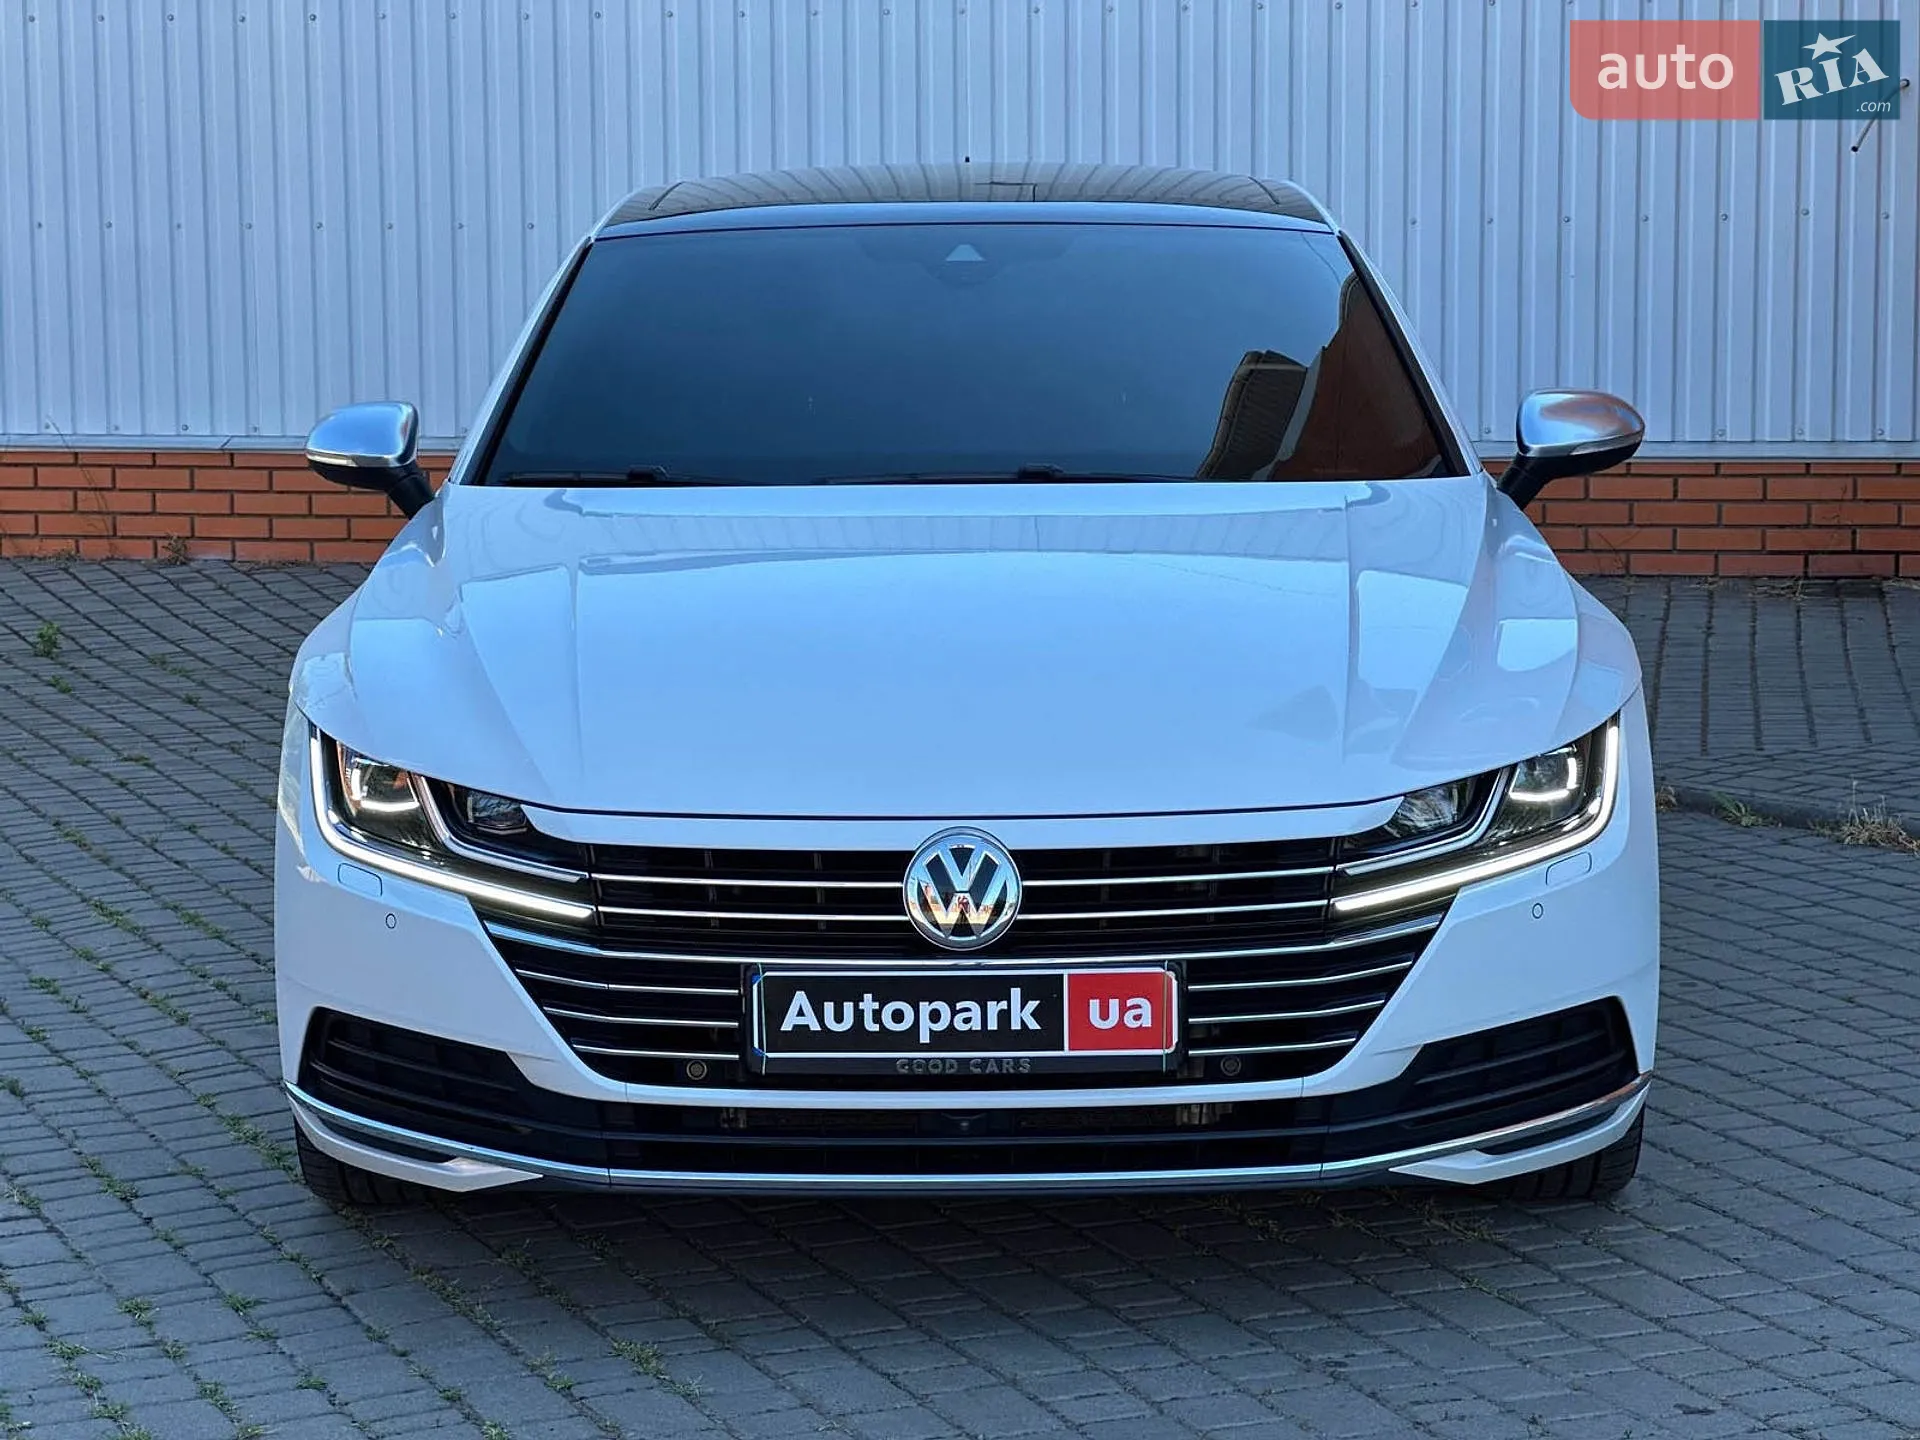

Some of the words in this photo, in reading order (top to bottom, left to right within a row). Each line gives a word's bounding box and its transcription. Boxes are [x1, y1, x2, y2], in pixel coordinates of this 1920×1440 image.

[780, 987, 1041, 1044] Autopark
[1088, 995, 1153, 1029] ua
[969, 1058, 1031, 1074] CARS
